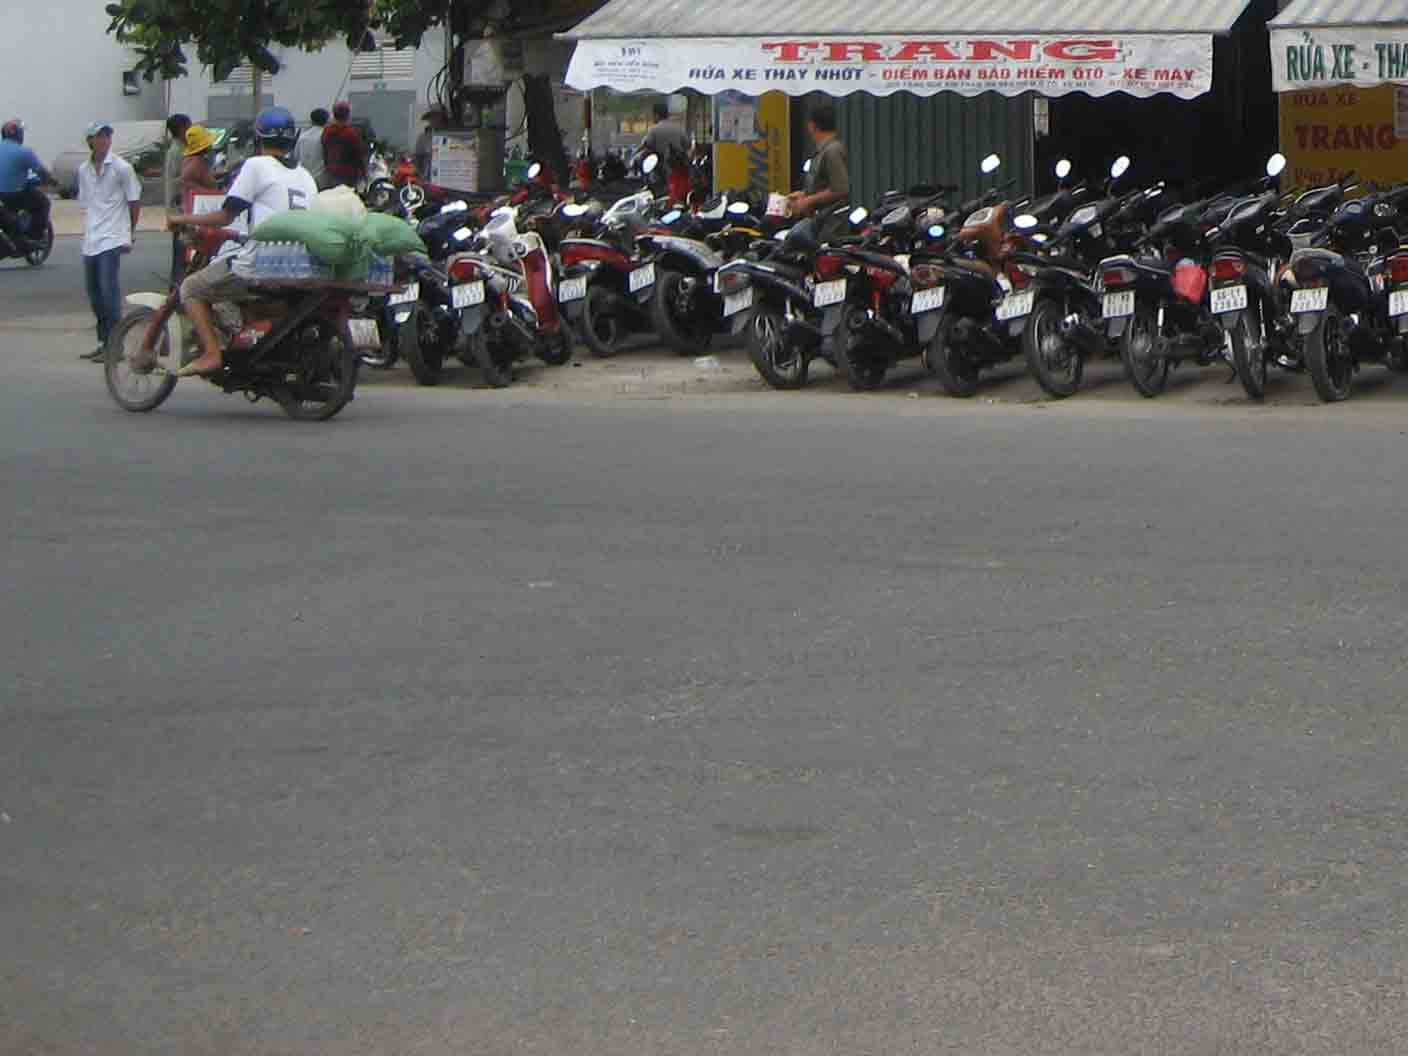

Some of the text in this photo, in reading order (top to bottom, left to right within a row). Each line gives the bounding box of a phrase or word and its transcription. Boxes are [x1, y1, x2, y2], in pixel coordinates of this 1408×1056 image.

[761, 40, 1121, 64] TRANG
[1287, 31, 1327, 81] RỬA
[1331, 44, 1356, 79] XE
[732, 69, 758, 81] XE
[764, 69, 808, 81] THAY
[1122, 68, 1148, 80] XE
[1294, 124, 1396, 151] TRANG
